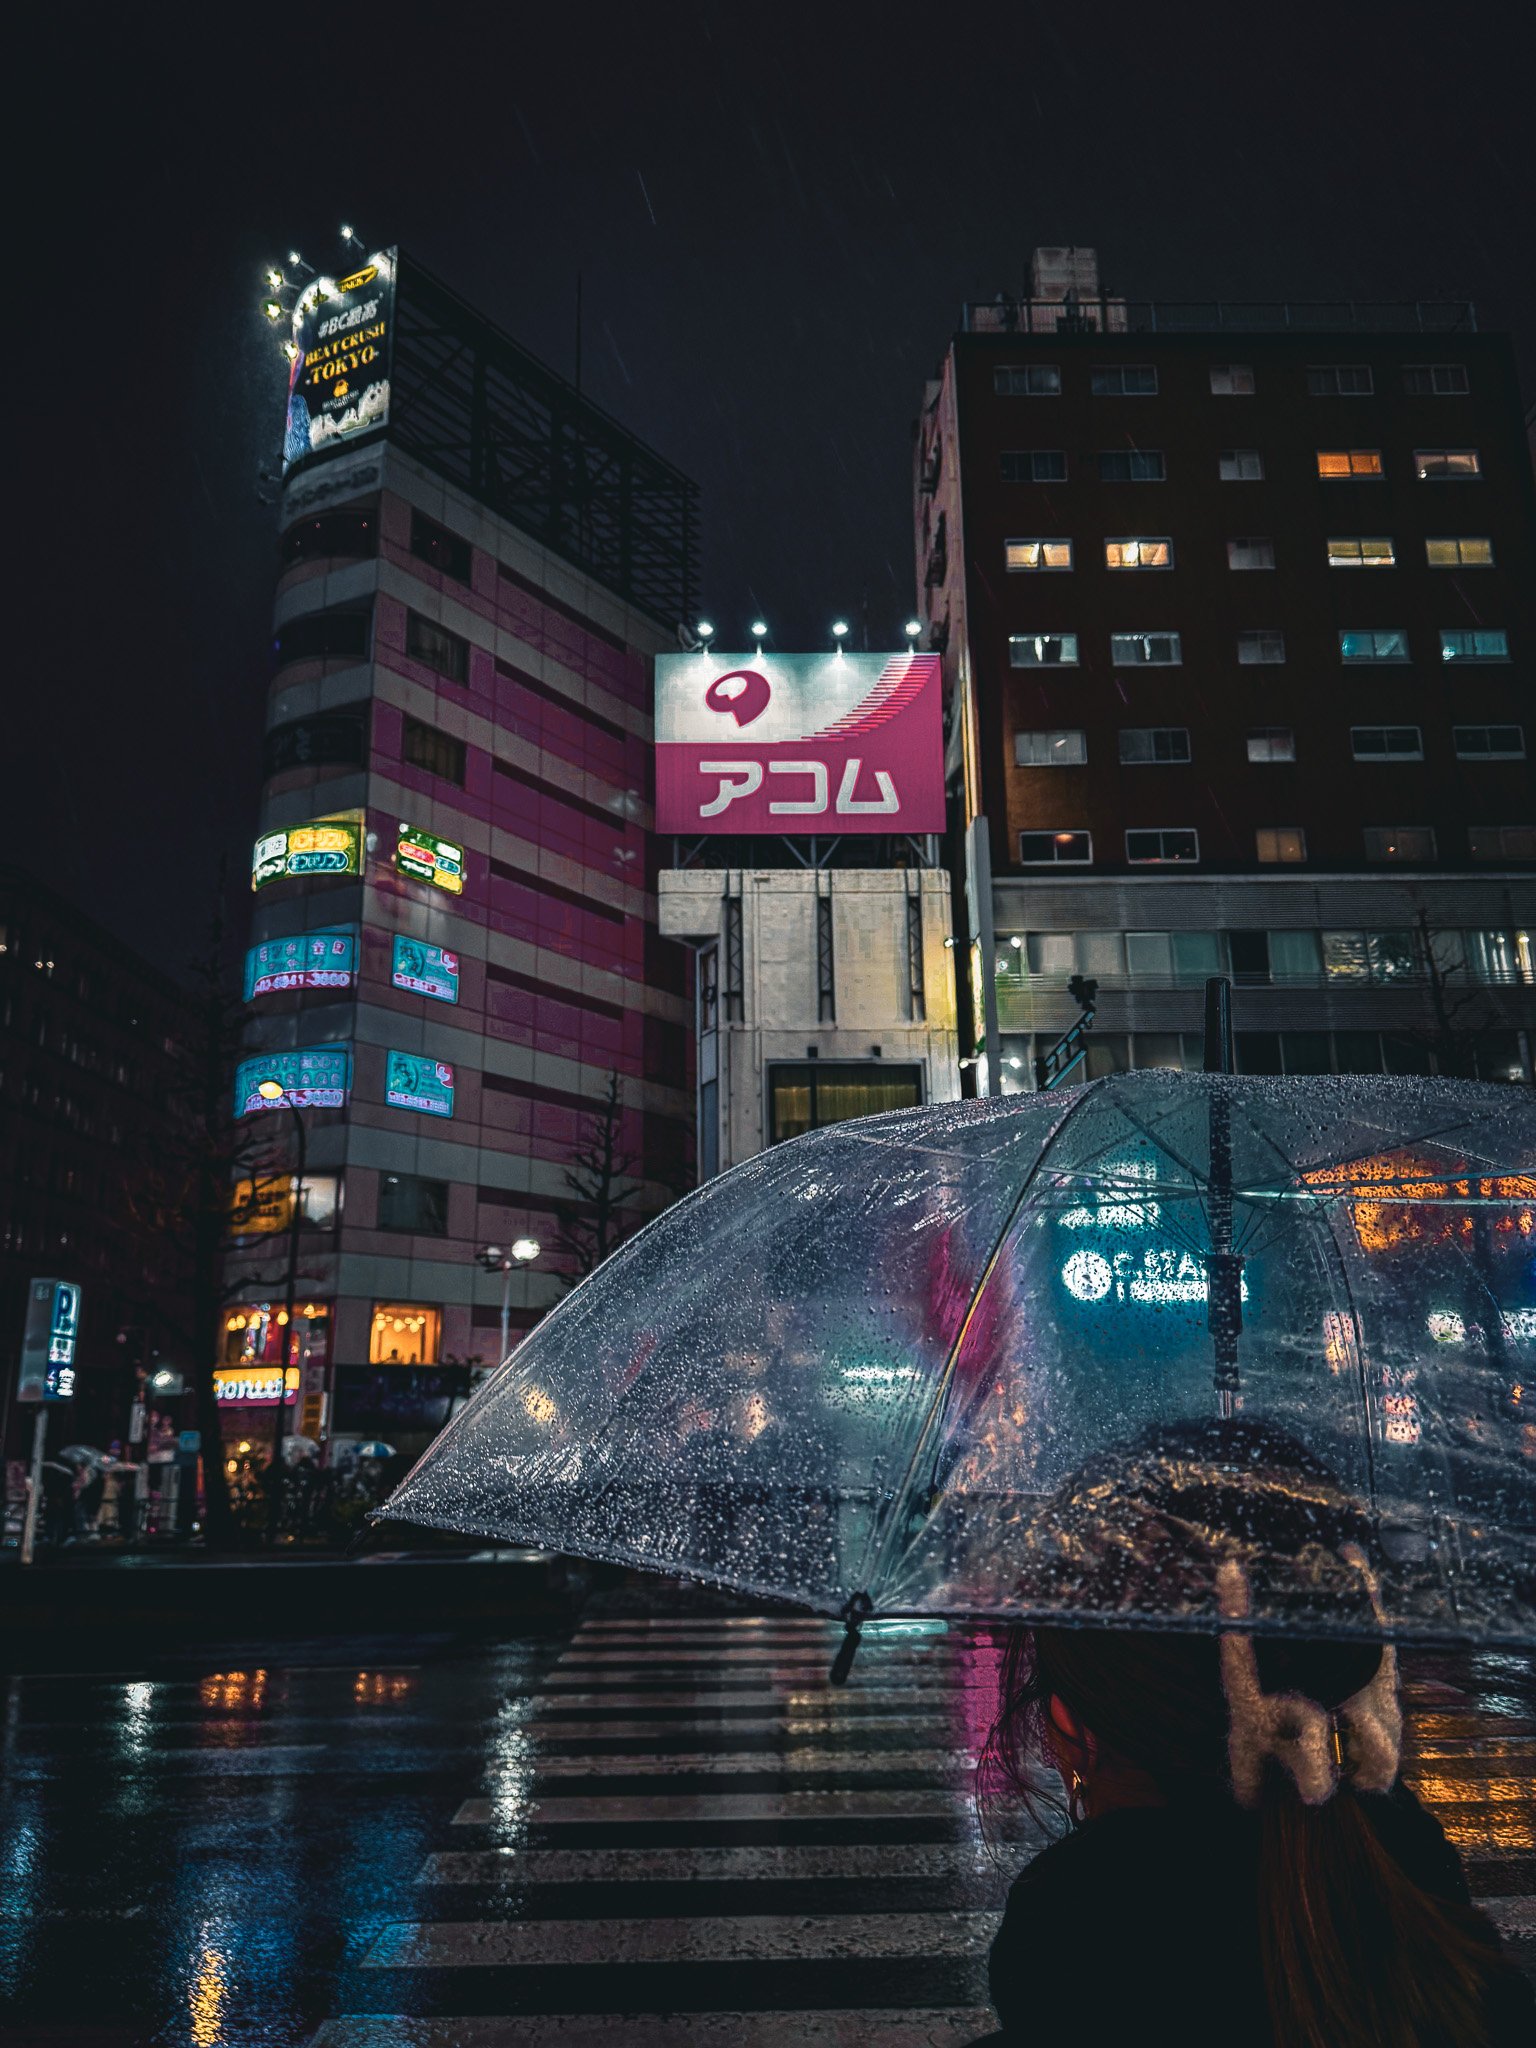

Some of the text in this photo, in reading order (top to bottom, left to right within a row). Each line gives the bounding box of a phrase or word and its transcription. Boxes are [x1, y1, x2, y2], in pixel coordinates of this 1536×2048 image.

[310, 345, 376, 384] TOKYO
[699, 758, 901, 818] アコム
